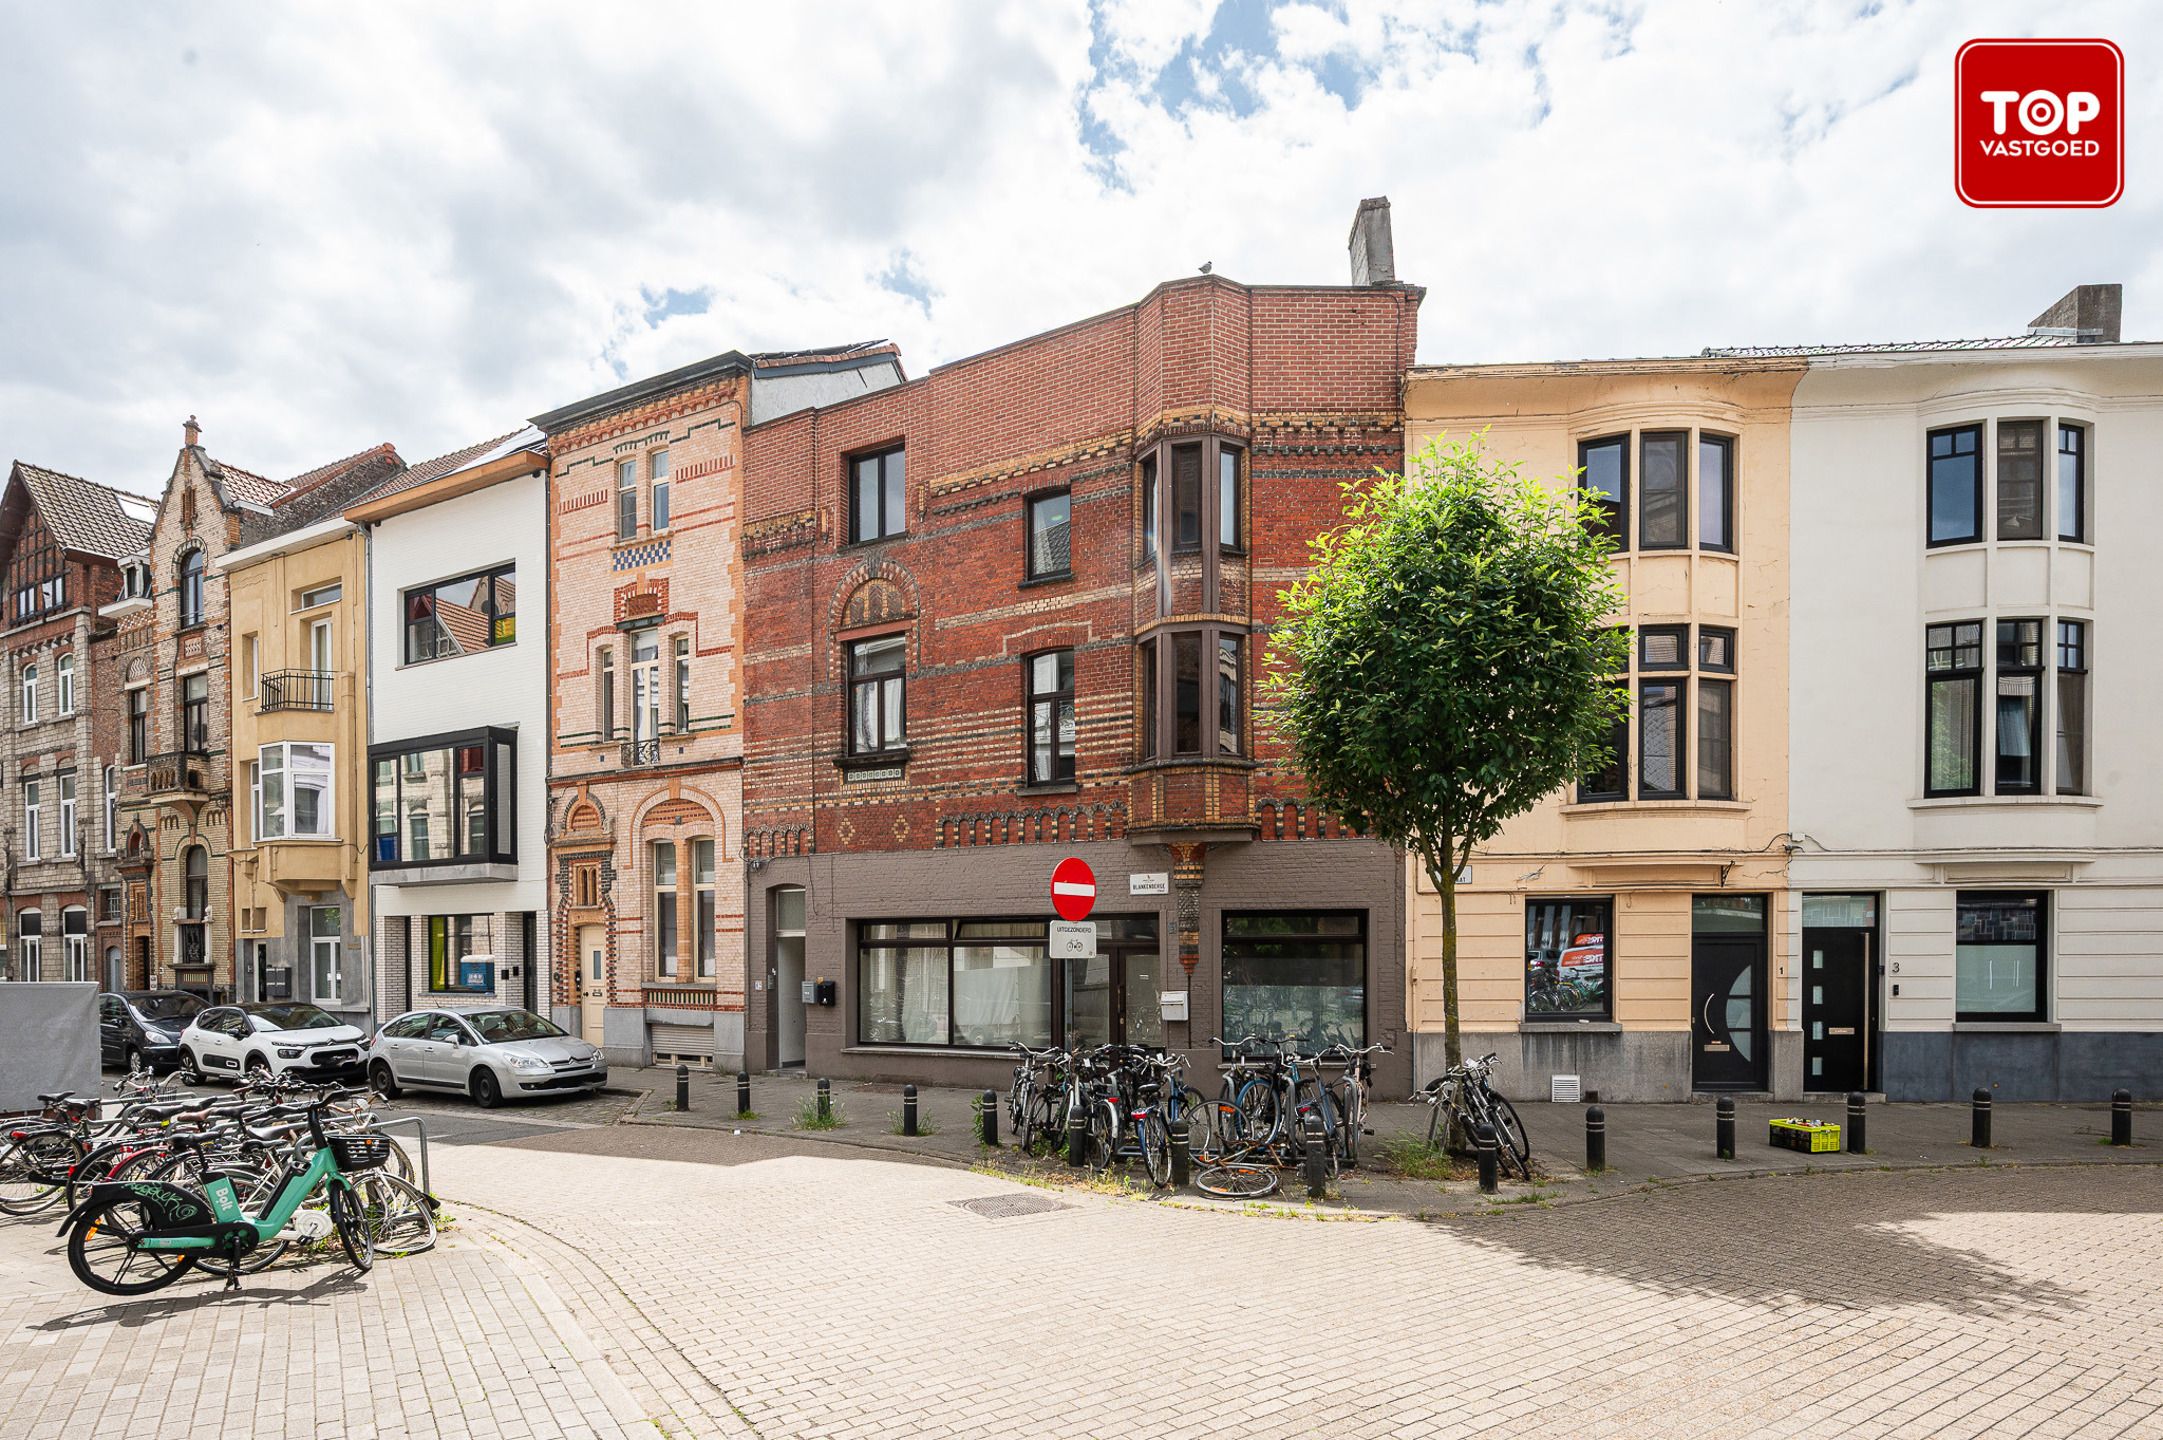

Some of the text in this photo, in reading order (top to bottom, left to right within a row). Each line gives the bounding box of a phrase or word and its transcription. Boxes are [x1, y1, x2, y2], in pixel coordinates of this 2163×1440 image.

[1056, 926, 1092, 934] UITGEZONDERD
[1780, 966, 1784, 975] 1
[1892, 962, 1900, 973] 3
[215, 1187, 233, 1212] Bolt
